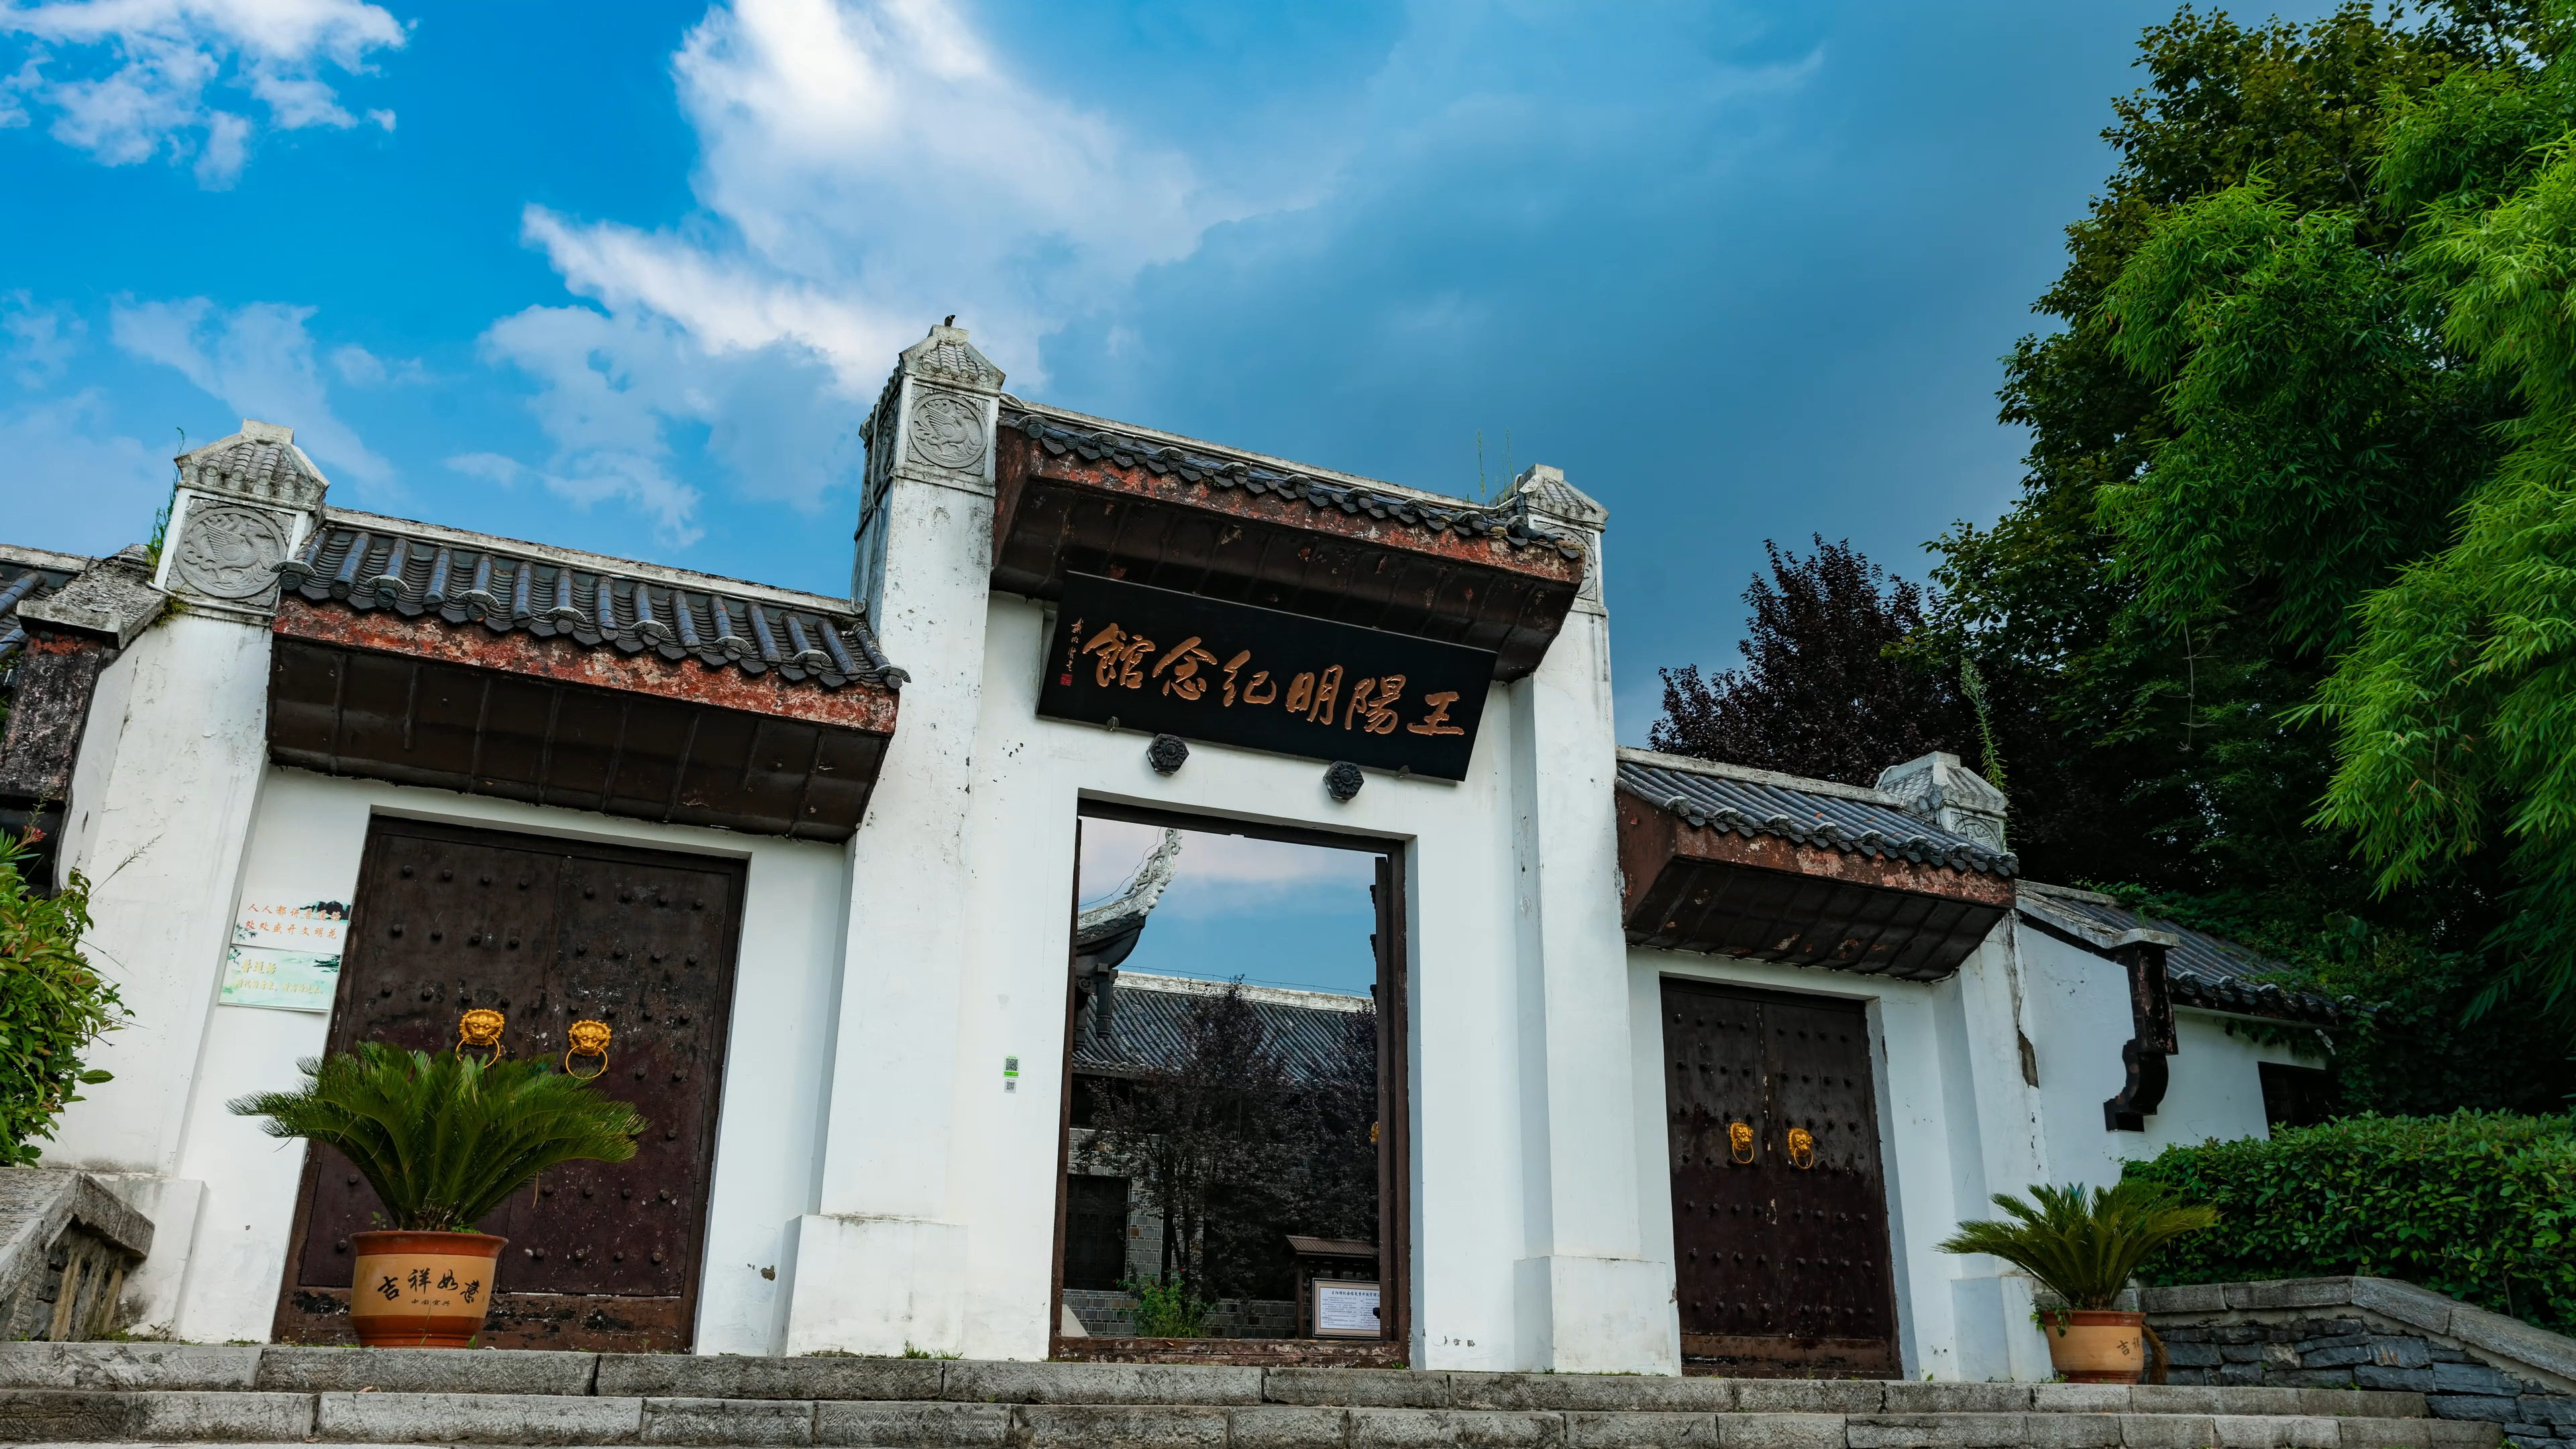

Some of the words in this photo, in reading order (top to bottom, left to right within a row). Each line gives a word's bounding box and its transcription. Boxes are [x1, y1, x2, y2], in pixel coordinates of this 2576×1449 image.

[248, 904, 341, 922] 人人都讲普通话
[246, 920, 337, 939] 处处盛开文明花
[241, 959, 276, 974] 普通话
[377, 1267, 480, 1304] 吉祥如意
